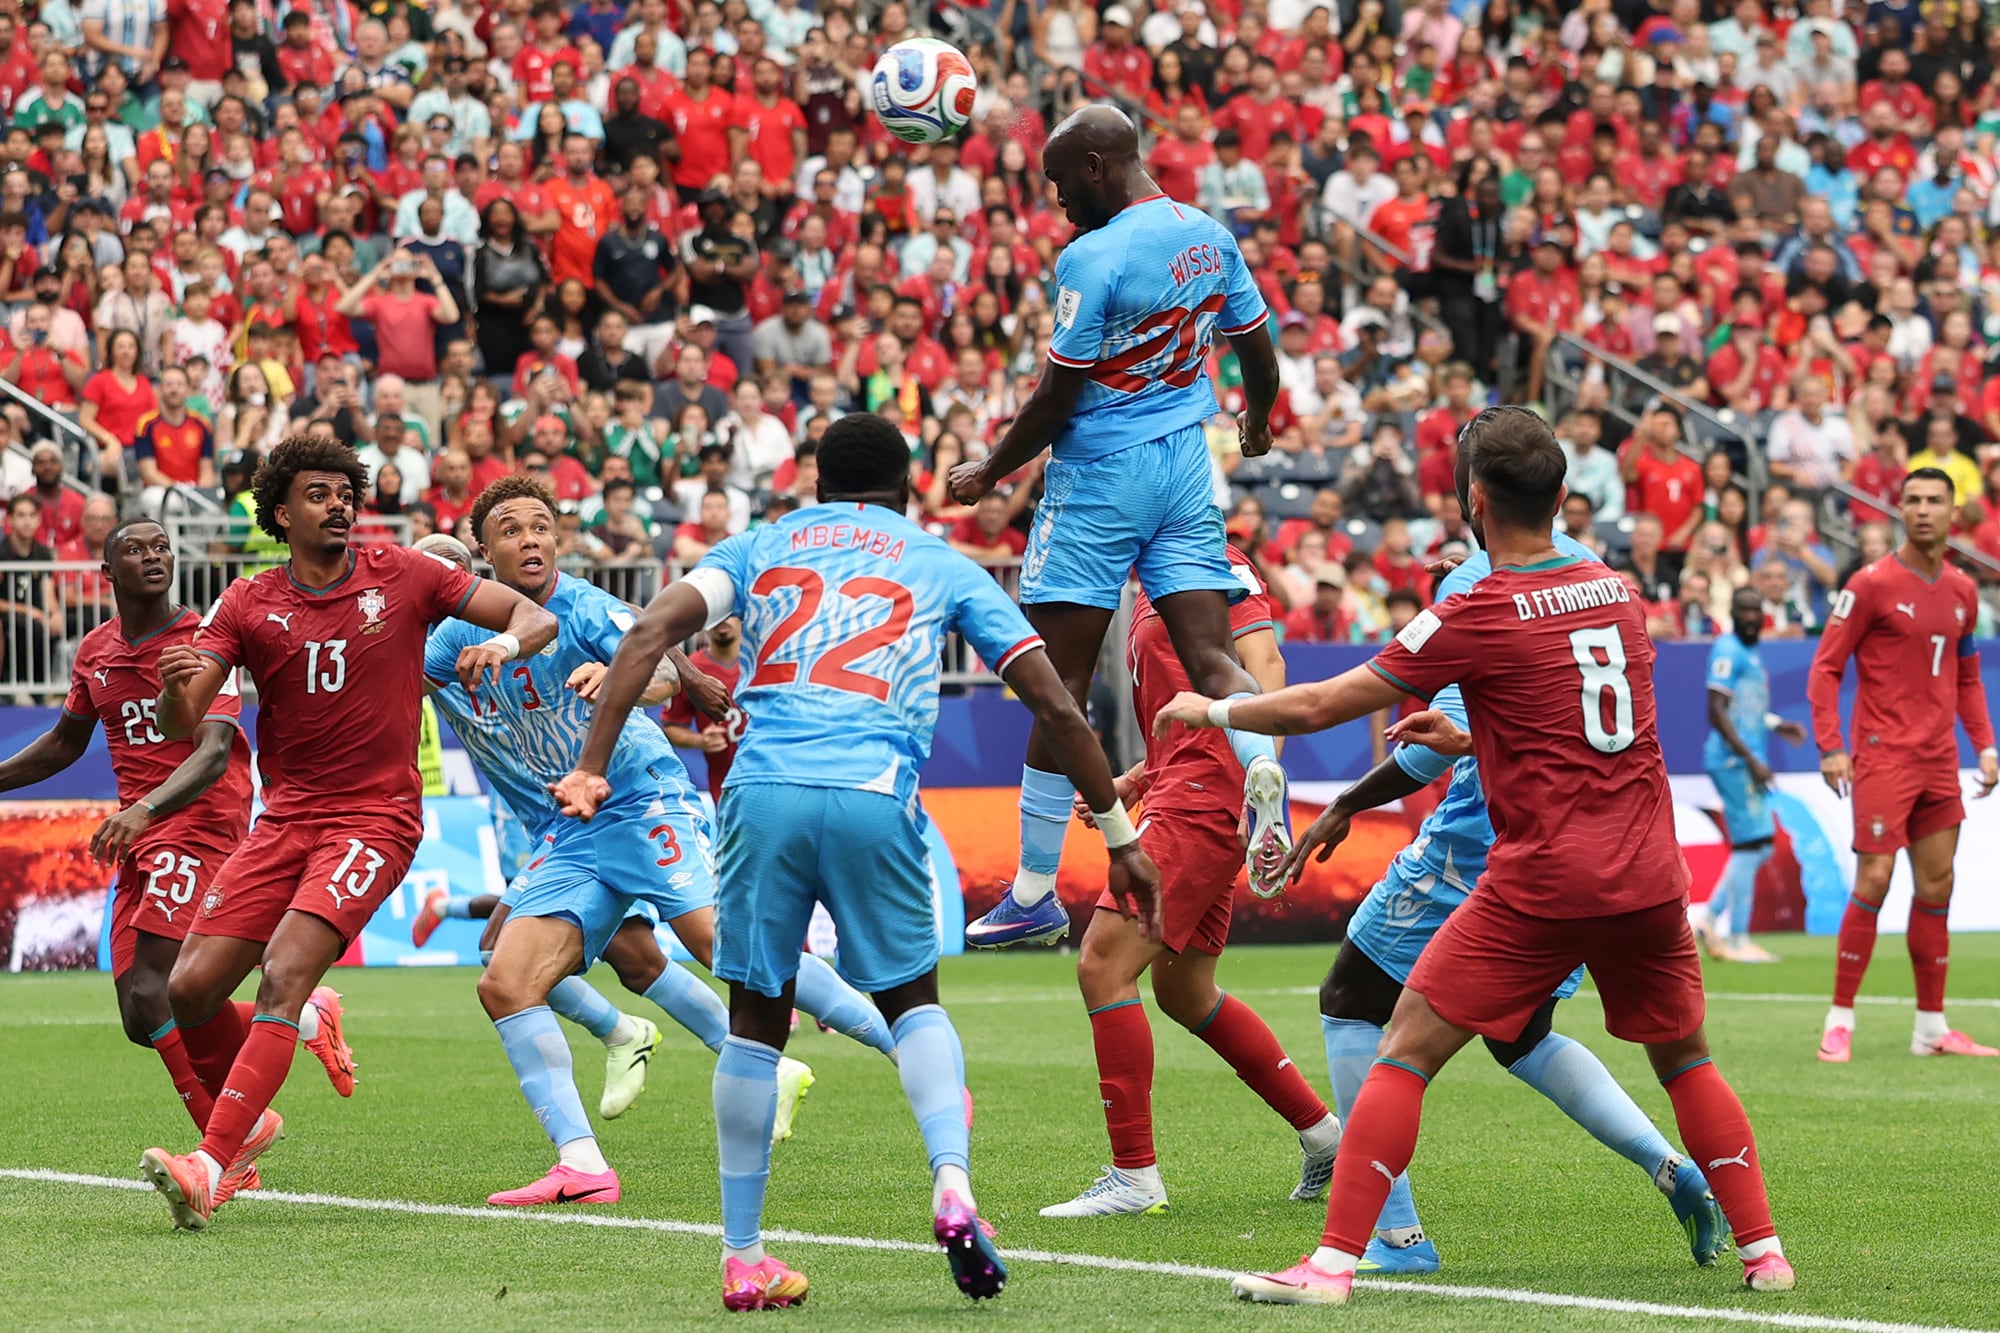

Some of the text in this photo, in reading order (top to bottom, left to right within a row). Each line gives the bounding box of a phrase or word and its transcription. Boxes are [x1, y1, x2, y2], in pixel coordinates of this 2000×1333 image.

[1168, 243, 1222, 288] WISSA
[791, 524, 906, 565] MBEMBA
[747, 566, 915, 705] 22
[1930, 634, 1946, 677] 7
[304, 639, 347, 694] 13
[513, 666, 541, 711] 3
[1568, 623, 1636, 754] 8
[121, 698, 166, 745] 25
[330, 838, 386, 897] 13
[648, 824, 682, 868] 3
[147, 851, 201, 904] 25
